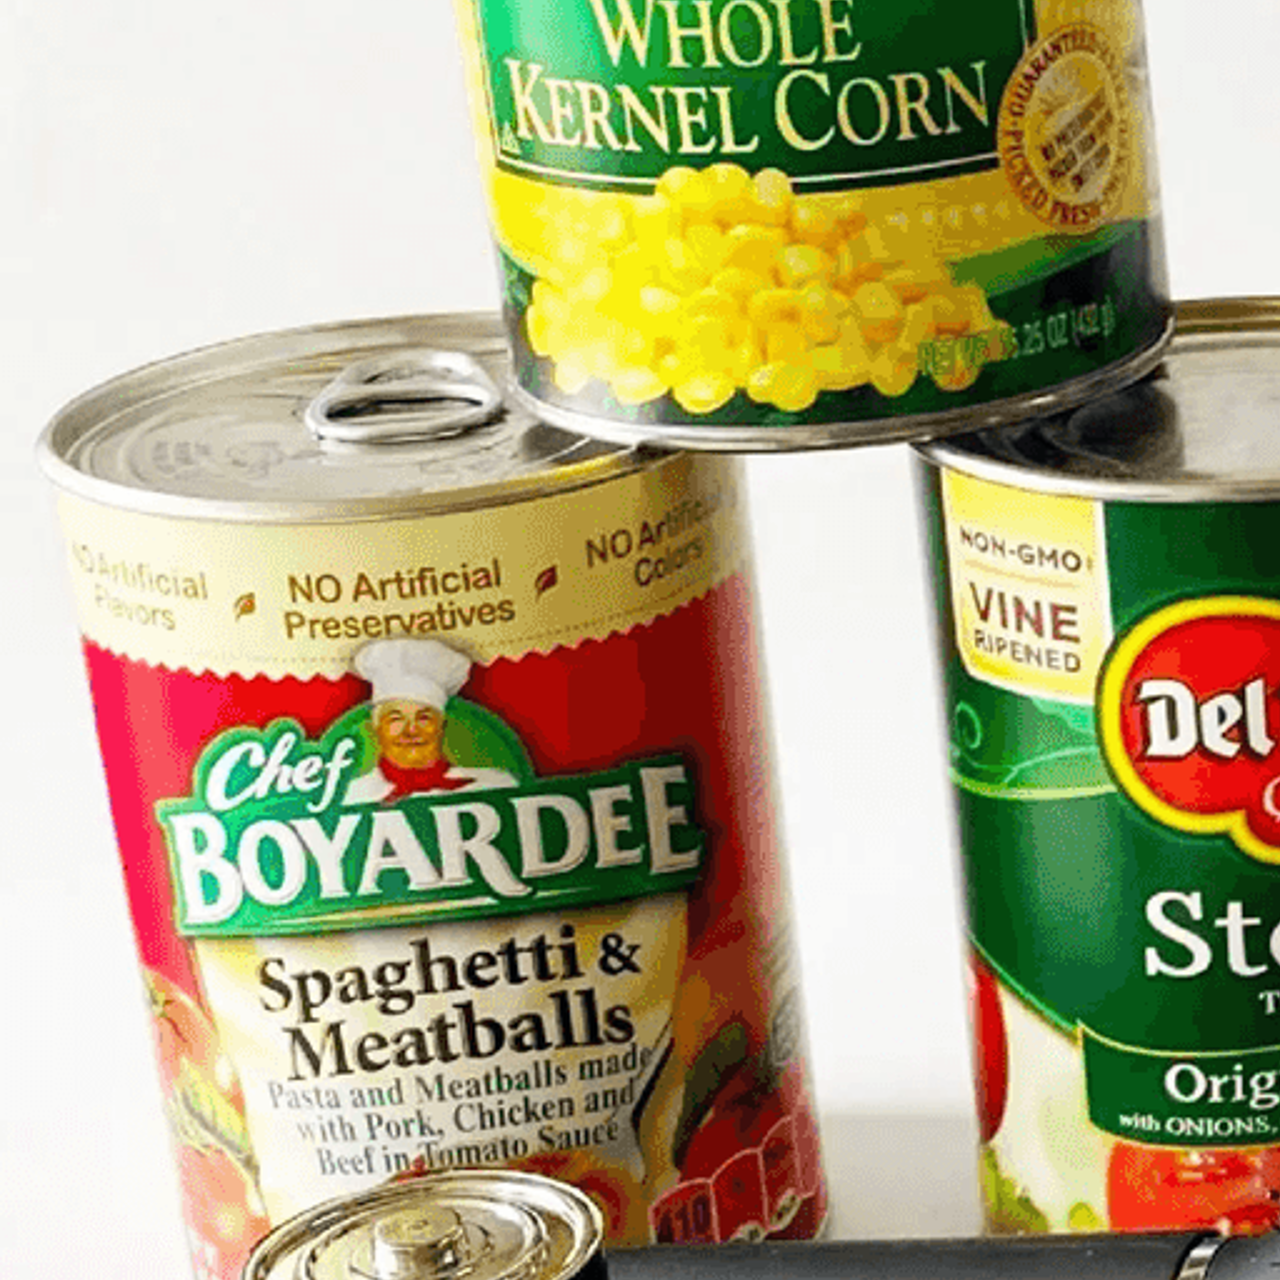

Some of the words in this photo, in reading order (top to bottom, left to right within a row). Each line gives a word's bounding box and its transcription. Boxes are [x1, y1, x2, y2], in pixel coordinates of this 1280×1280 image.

[506, 57, 760, 154] KERNEL
[775, 62, 990, 153] CORN
[585, 528, 633, 569] NO
[959, 524, 1082, 572] NON-GMO
[287, 573, 342, 604] NO
[352, 559, 503, 602] Artificial
[968, 580, 1082, 645] VINE
[284, 594, 517, 640] Preservatives
[973, 628, 1082, 674] RIPENED
[1138, 678, 1275, 759] Del
[206, 730, 355, 815] Chef
[176, 763, 701, 924] BOYARDEE
[258, 925, 584, 1019] Spaghetti
[597, 930, 643, 975] &
[282, 989, 637, 1082] Meatballs
[267, 1078, 341, 1110] Pasta
[350, 1076, 404, 1109] and
[414, 1057, 568, 1104] Meatballs
[578, 1041, 654, 1081] made
[298, 1115, 355, 1144] with
[364, 1110, 446, 1142] Pork,
[454, 1091, 575, 1133] Chicken
[583, 1077, 636, 1109] and
[1118, 1112, 1162, 1134] with
[1164, 1114, 1278, 1138] ONIONS,
[316, 1145, 377, 1177] Beef
[384, 1143, 411, 1175] in
[419, 1130, 530, 1168] Tomato
[537, 1120, 619, 1154] Sauce
